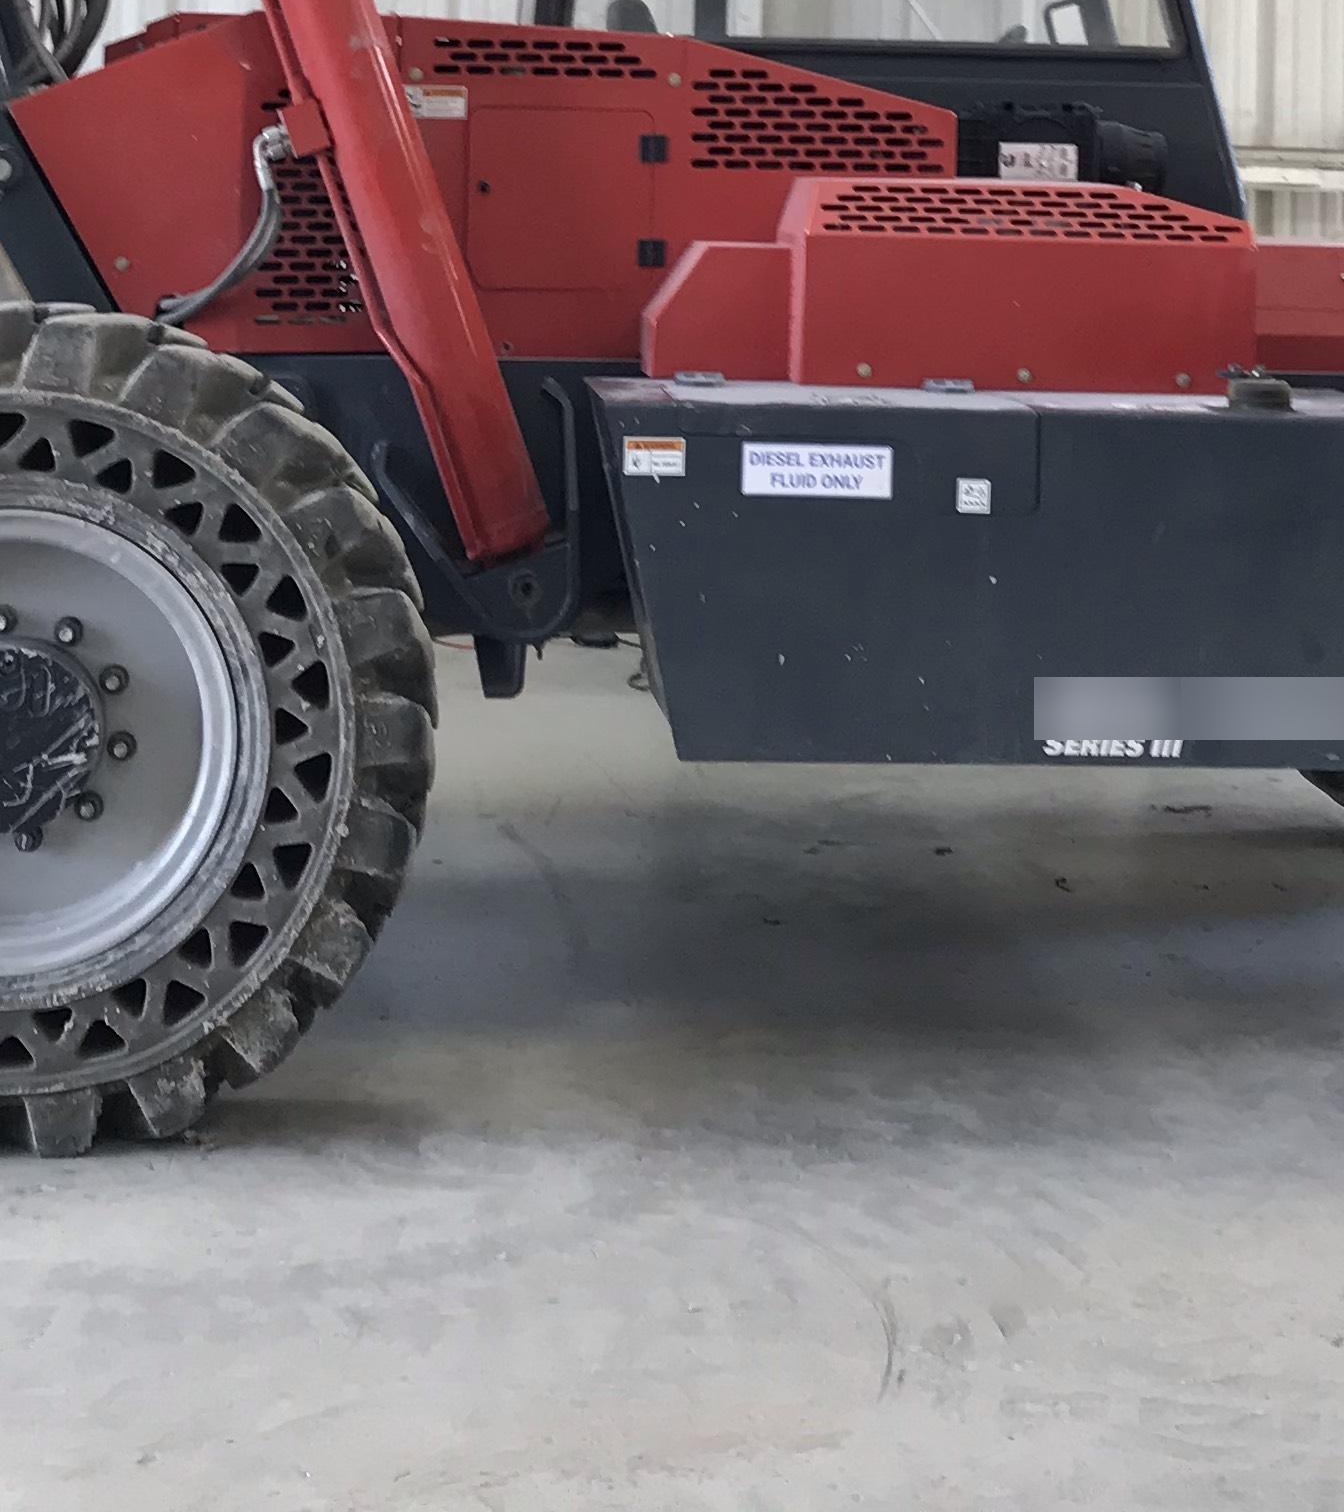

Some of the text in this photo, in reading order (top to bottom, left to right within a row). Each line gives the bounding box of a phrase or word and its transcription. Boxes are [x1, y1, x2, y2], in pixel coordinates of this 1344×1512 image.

[749, 451, 886, 470] DIESEL EXHAUST
[770, 472, 864, 490] FLUID ONLY
